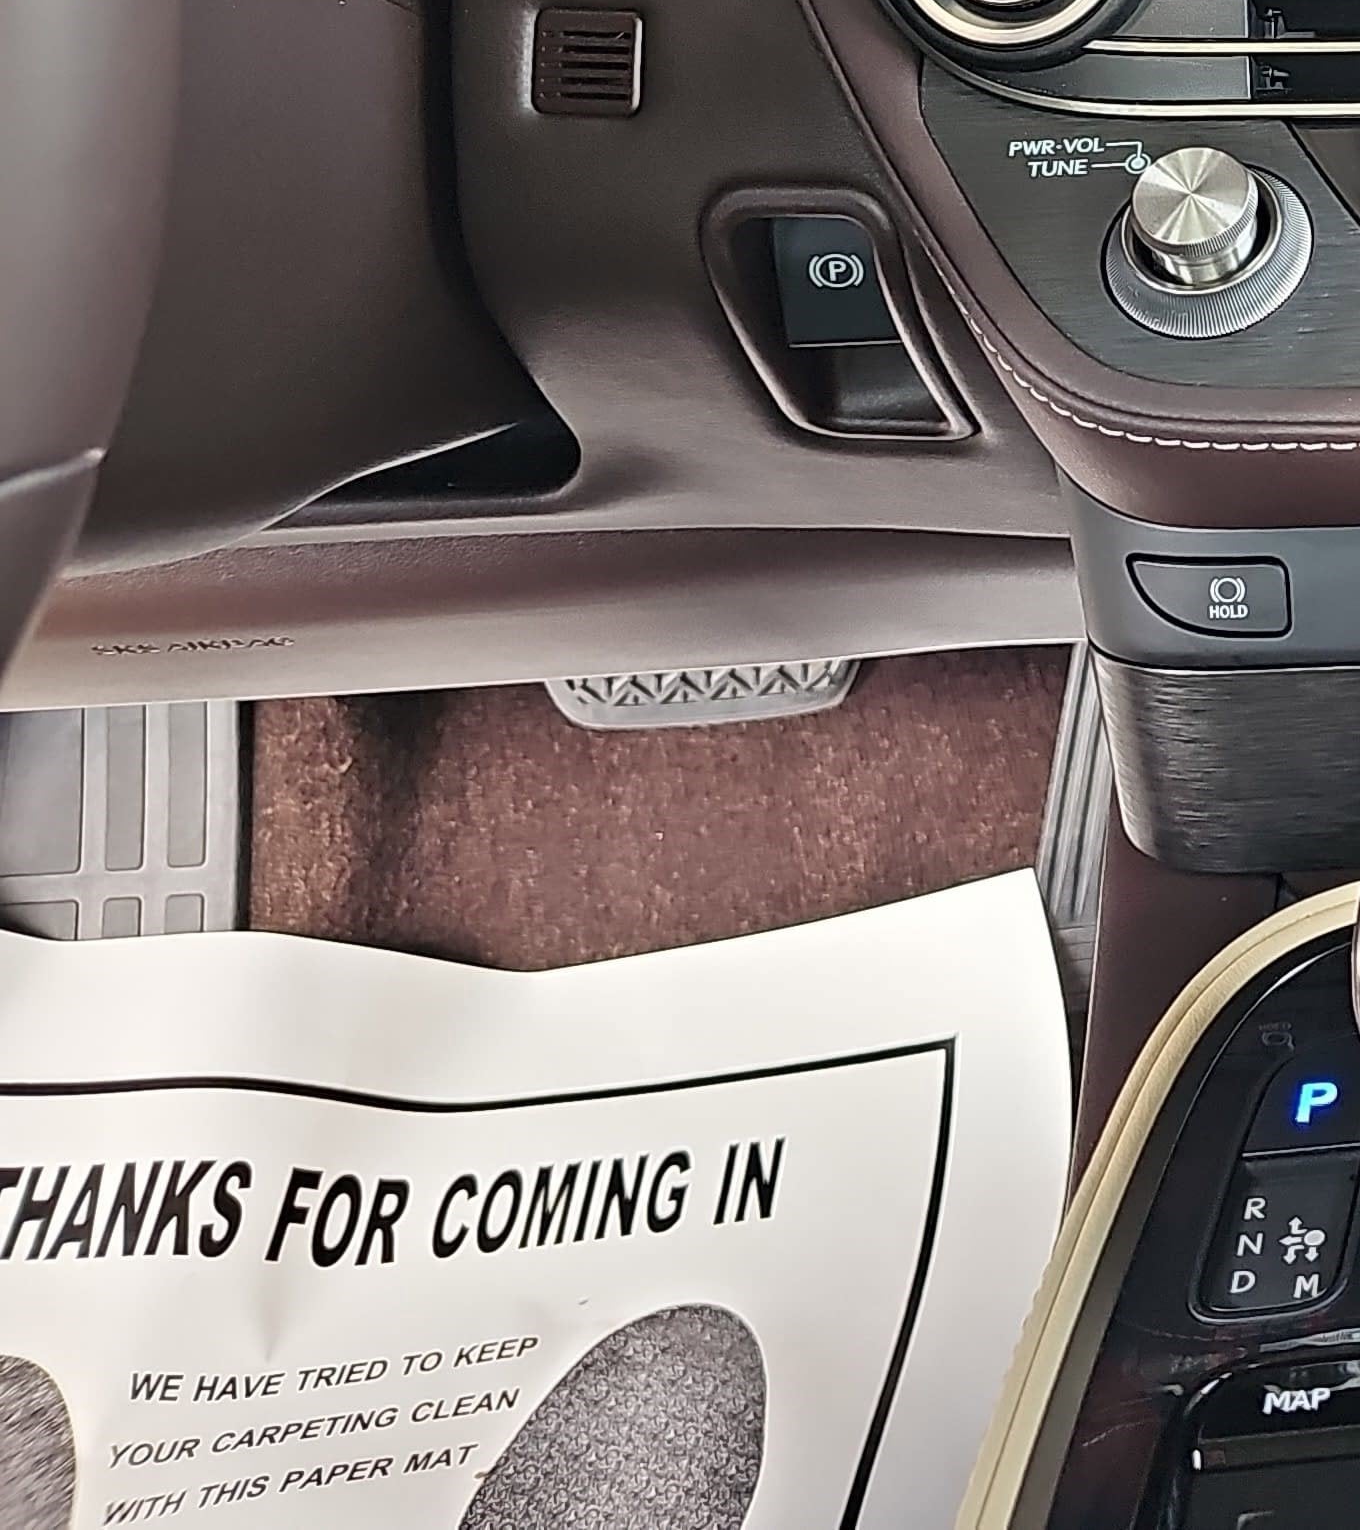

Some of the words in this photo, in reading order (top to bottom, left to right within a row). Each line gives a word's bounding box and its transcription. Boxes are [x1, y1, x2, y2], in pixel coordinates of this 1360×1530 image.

[1027, 159, 1089, 177] TUNE
[1208, 604, 1249, 620] HOLD
[1295, 1081, 1339, 1124] P
[264, 1166, 410, 1267] FOR
[432, 1149, 694, 1258] COMING
[713, 1137, 788, 1227] IN
[1243, 1197, 1267, 1221] R
[1237, 1232, 1263, 1256] N
[1230, 1271, 1256, 1295] D
[1293, 1274, 1321, 1299] M
[129, 1373, 184, 1401] WE
[193, 1373, 285, 1402] HAVE
[297, 1359, 389, 1392] TRIED
[402, 1351, 443, 1376] TO
[453, 1336, 539, 1368] KEEP
[1262, 1387, 1331, 1414] MAP
[109, 1438, 200, 1468] YOUR
[211, 1407, 398, 1454] CARPETING
[411, 1388, 520, 1423] CLEAN
[103, 1490, 187, 1527] WITH
[198, 1475, 270, 1509] THIS
[279, 1457, 394, 1493] PAPER
[403, 1444, 478, 1474] MAT
